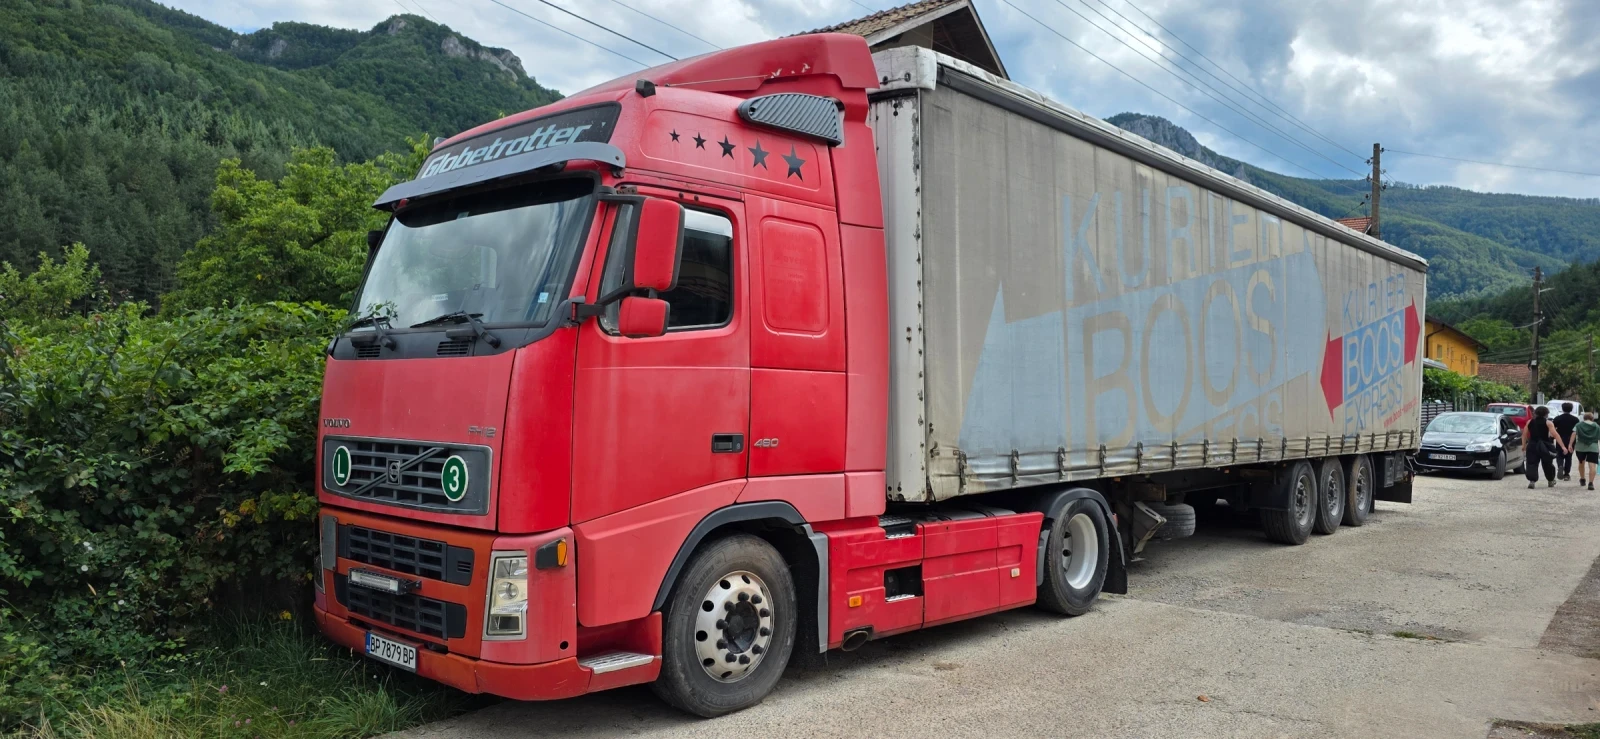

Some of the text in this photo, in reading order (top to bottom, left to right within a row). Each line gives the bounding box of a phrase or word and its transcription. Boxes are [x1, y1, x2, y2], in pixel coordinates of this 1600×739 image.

[421, 124, 592, 179] Globetrotter
[1343, 273, 1405, 333] KURIER
[1083, 269, 1277, 464] BOOS
[1346, 314, 1402, 395] BOOS
[322, 418, 352, 429] VOLVO
[1344, 371, 1403, 440] EXPRESS
[753, 438, 779, 448] 480
[337, 454, 345, 478] L
[449, 465, 459, 492] 3
[370, 636, 415, 665] BP 7879 BP
